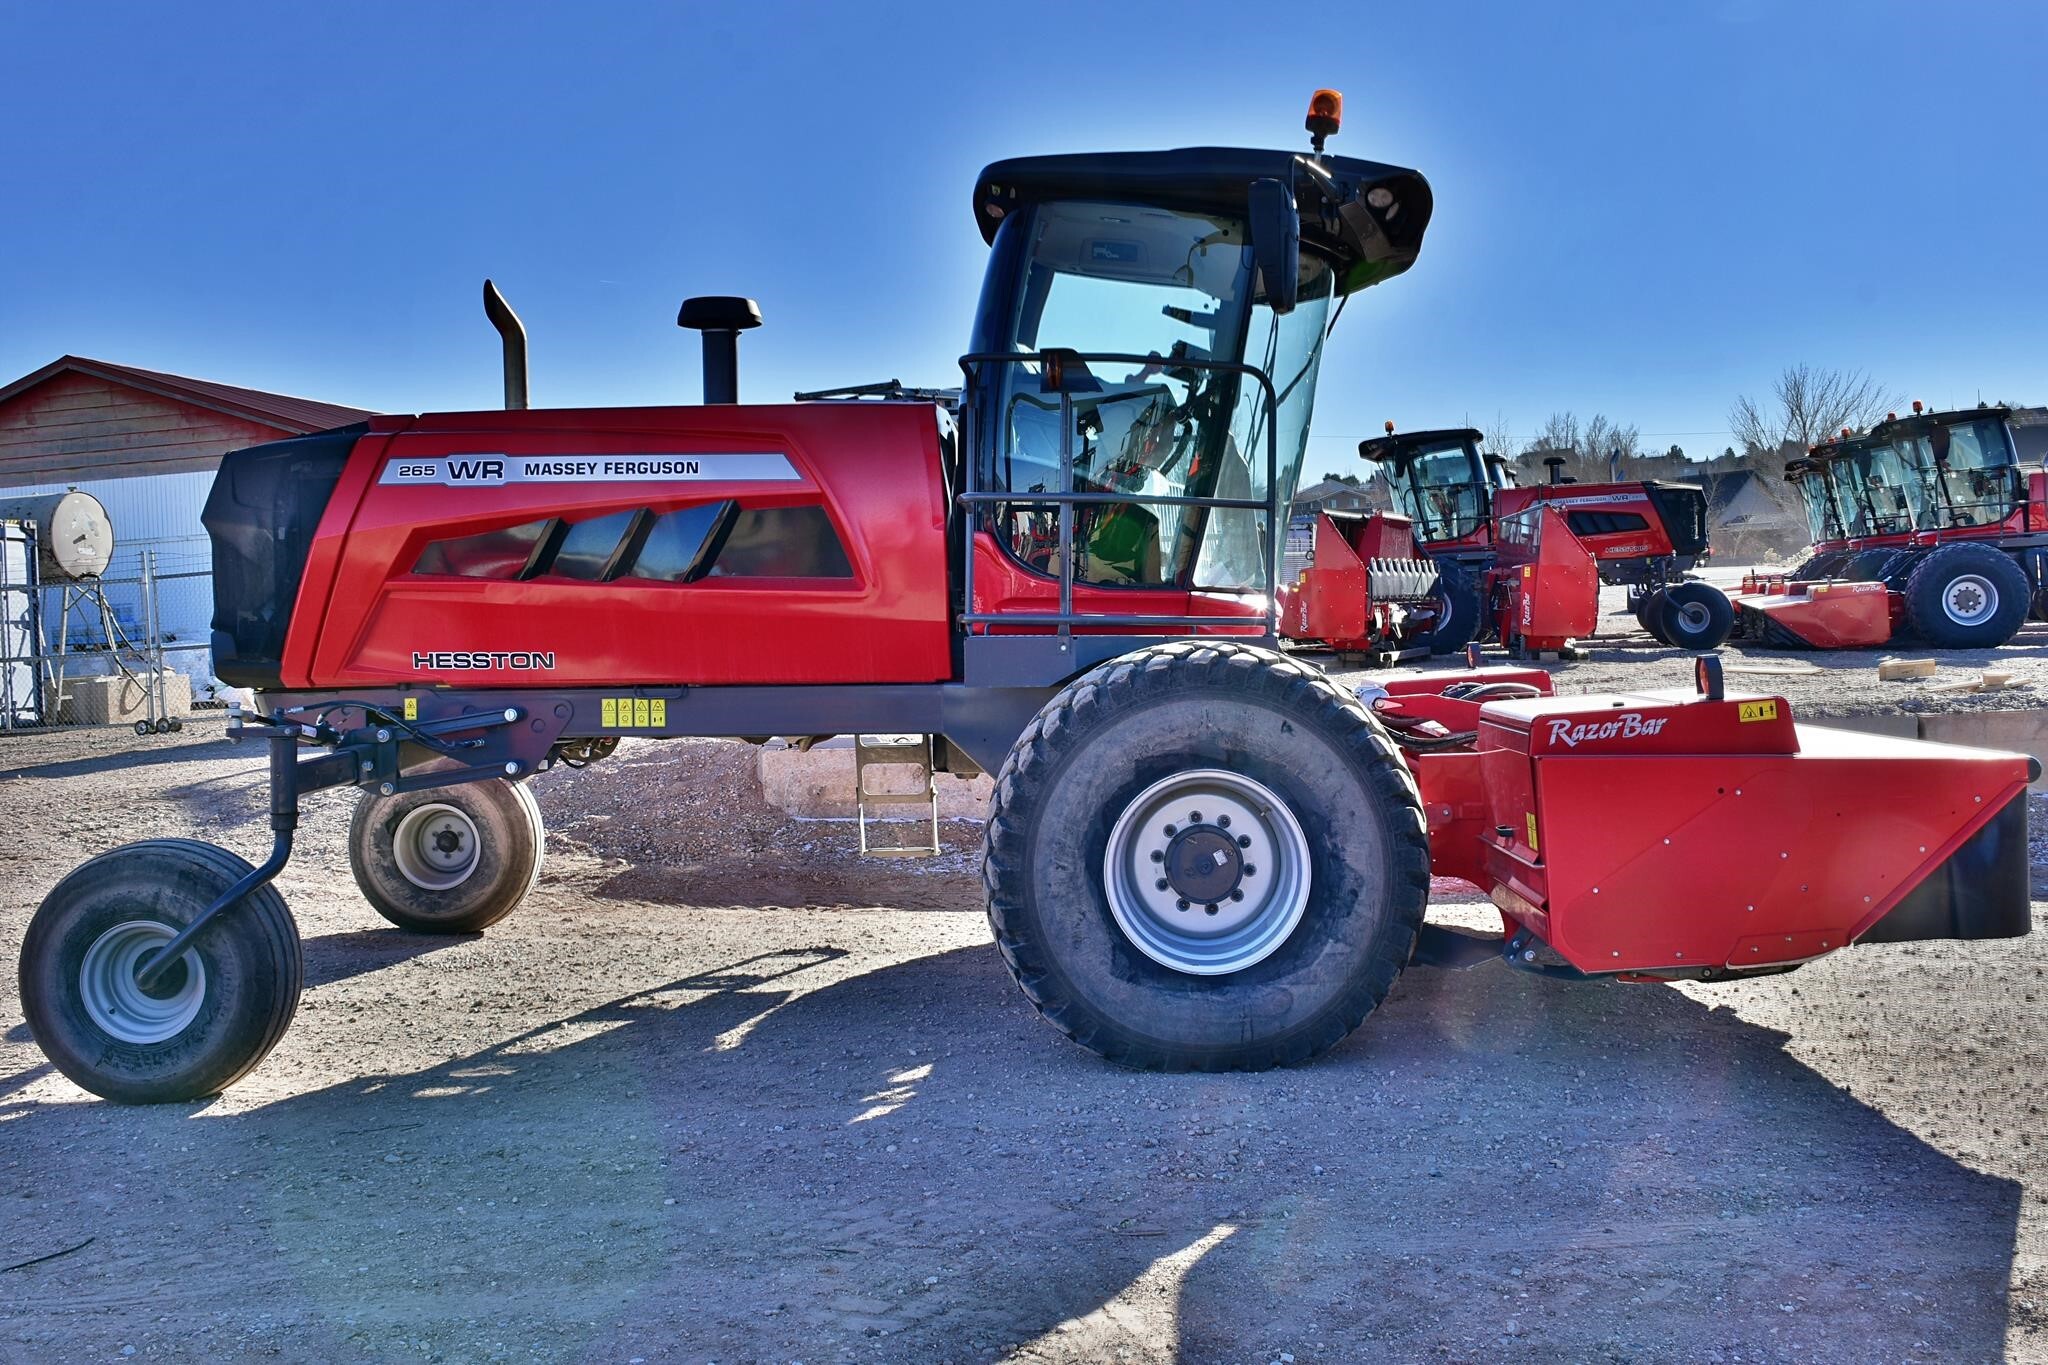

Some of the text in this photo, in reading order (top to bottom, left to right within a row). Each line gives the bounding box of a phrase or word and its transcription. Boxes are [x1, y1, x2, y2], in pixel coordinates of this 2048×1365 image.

[399, 460, 699, 480] 265 WR MASSEY FERGUSON
[412, 651, 556, 670] HESSTON
[1546, 713, 1668, 748] RazorBar
